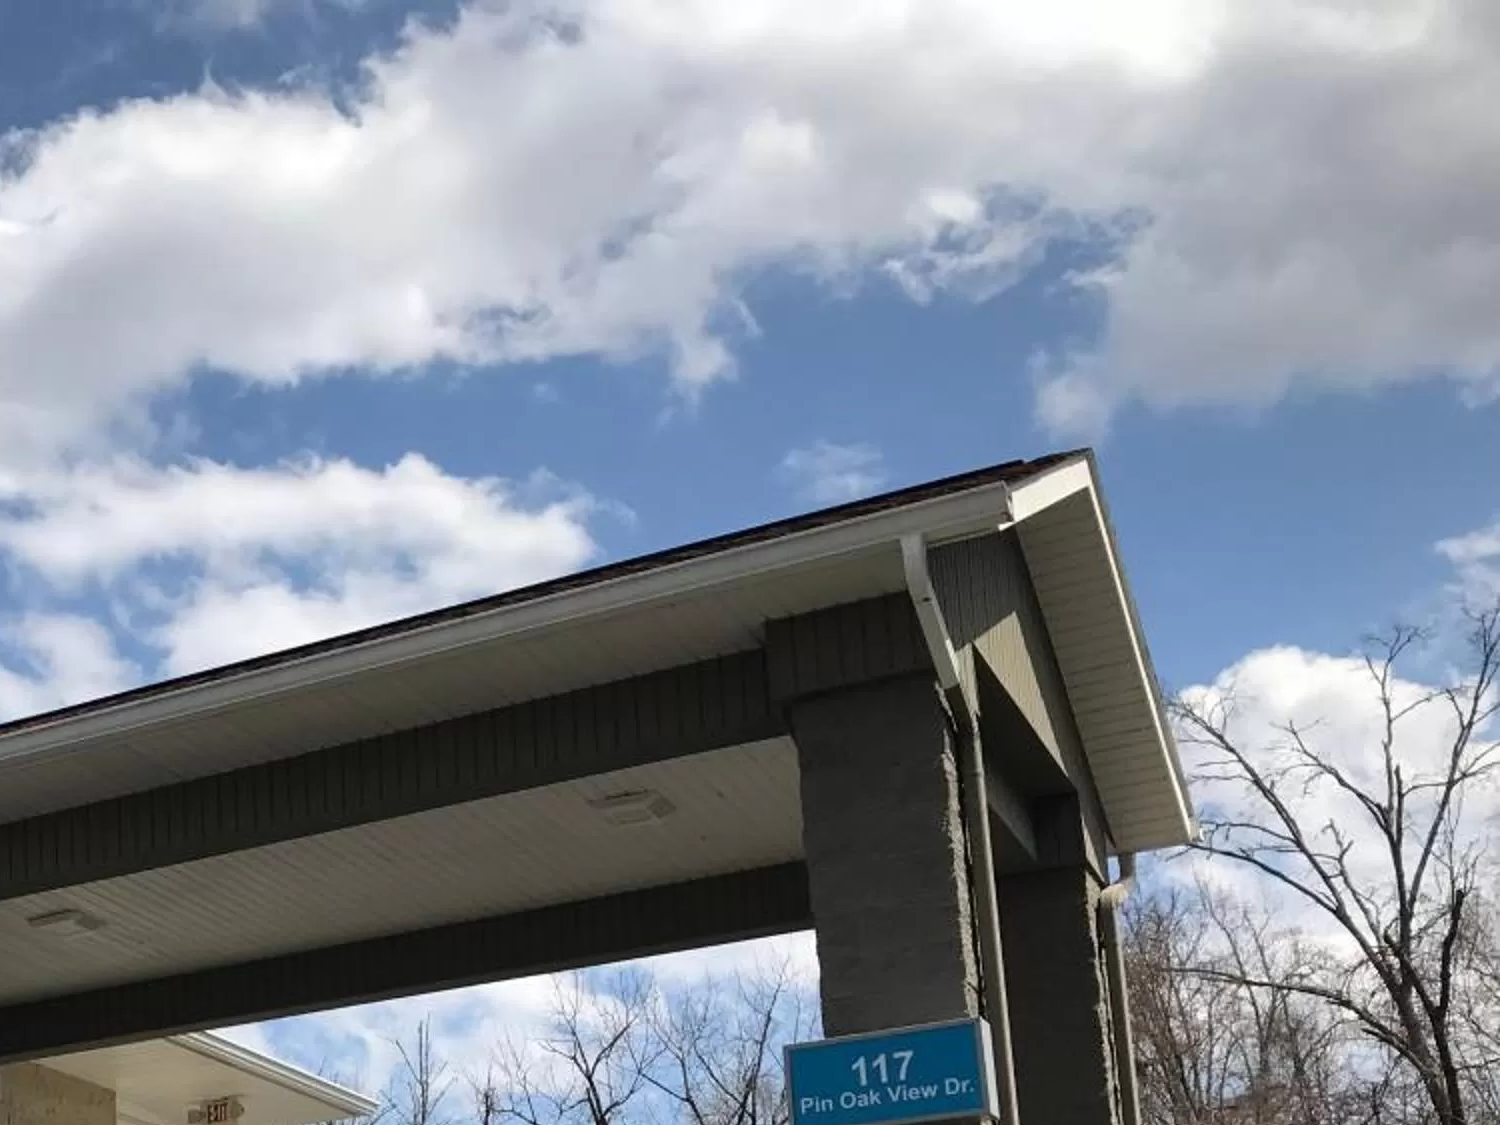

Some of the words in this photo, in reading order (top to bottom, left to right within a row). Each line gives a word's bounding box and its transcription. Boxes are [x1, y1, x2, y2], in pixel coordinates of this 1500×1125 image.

[851, 1050, 914, 1087] 117
[801, 1097, 833, 1115] Pin
[839, 1089, 882, 1109] Oak
[887, 1083, 938, 1102] View
[945, 1078, 975, 1096] Dr.
